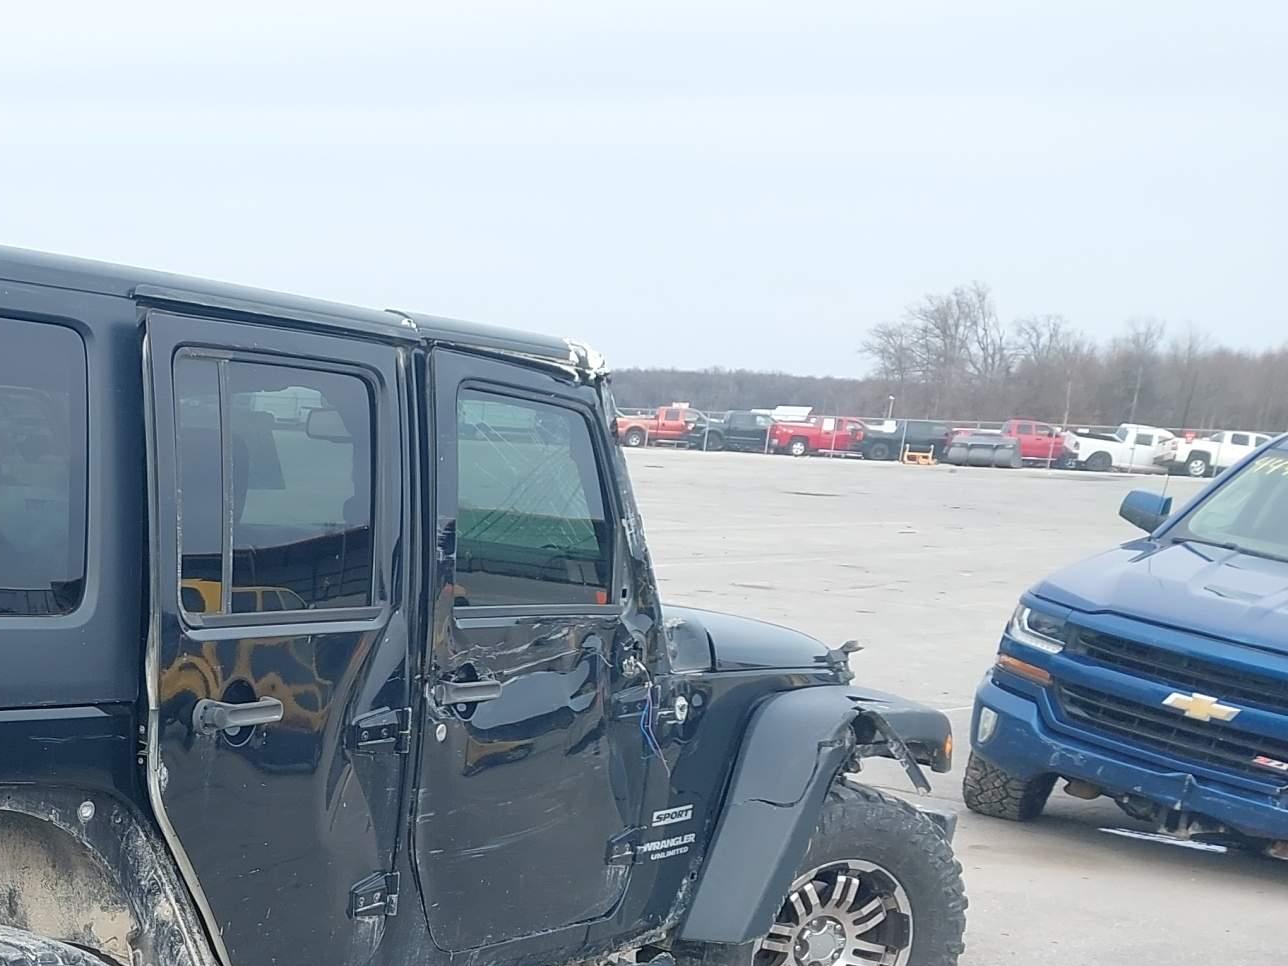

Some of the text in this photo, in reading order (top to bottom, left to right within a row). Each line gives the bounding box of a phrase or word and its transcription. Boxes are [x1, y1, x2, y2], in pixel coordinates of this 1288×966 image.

[654, 808, 691, 823] SPORT
[638, 833, 696, 852] WRANGLER
[650, 846, 689, 861] UNLIMITED
